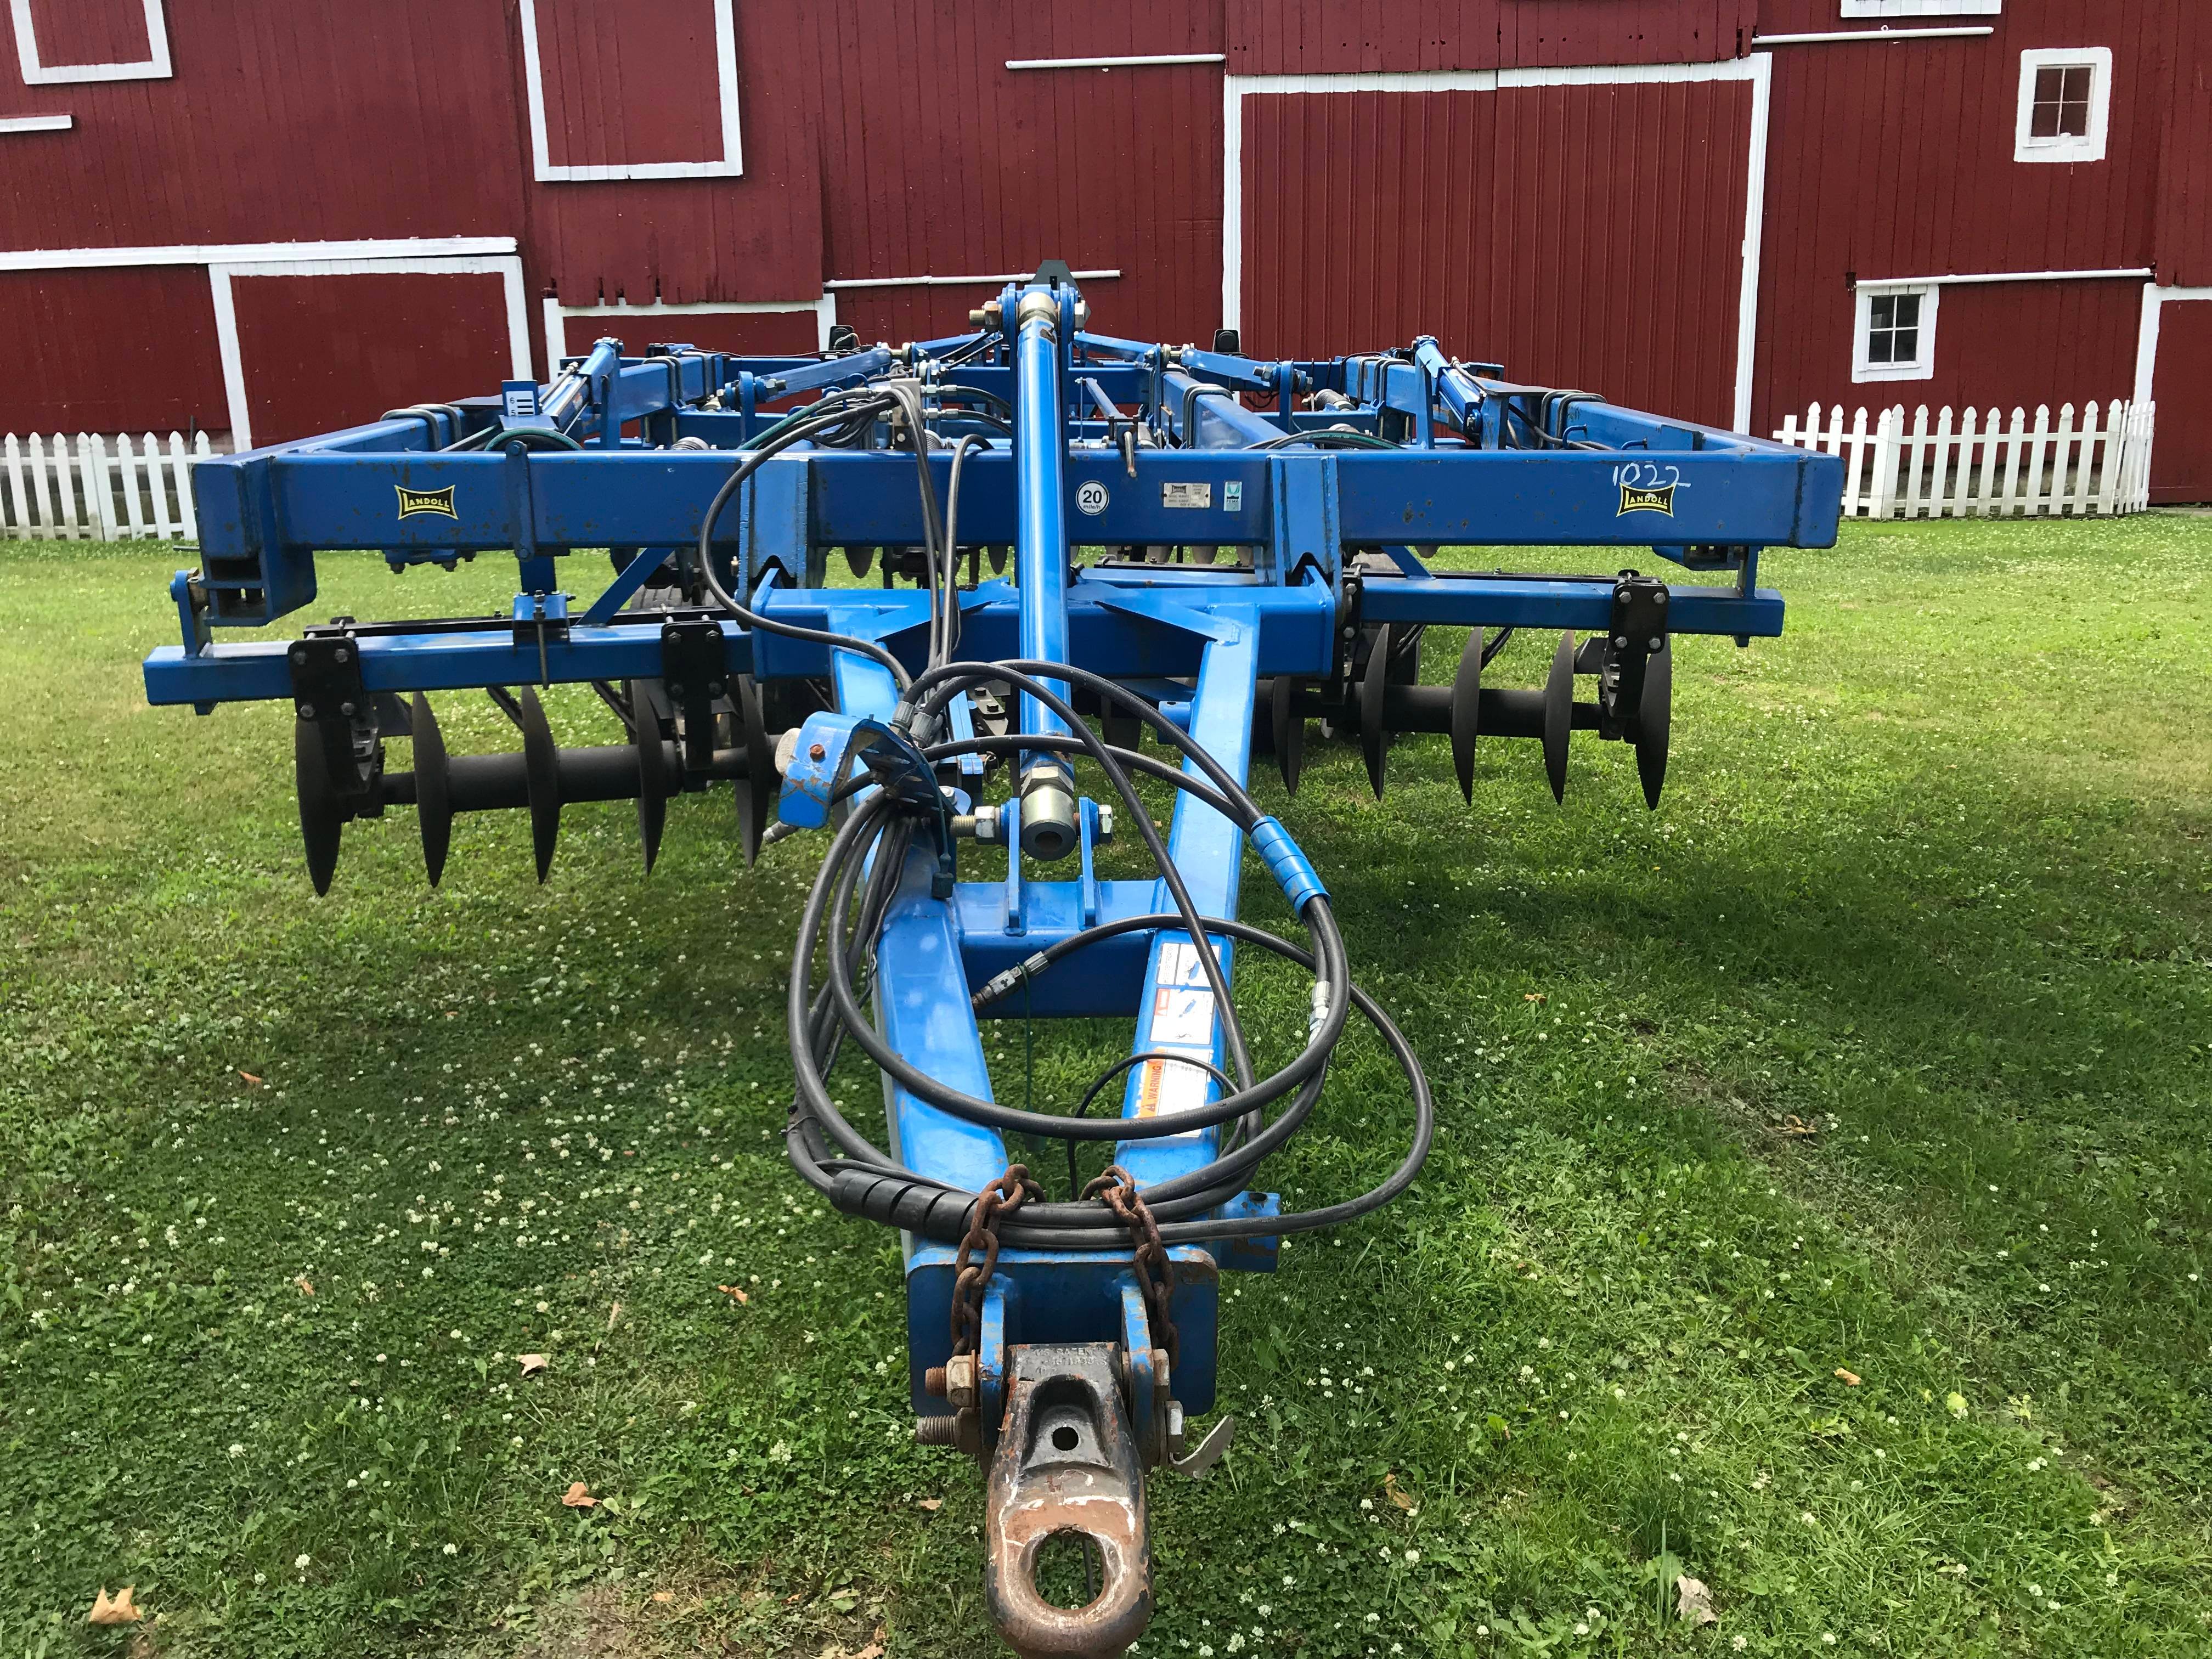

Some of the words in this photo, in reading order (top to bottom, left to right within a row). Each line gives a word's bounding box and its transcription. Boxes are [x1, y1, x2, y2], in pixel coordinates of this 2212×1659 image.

[1612, 462, 1691, 488] 1022
[402, 493, 450, 512] LANDOLL
[1083, 490, 1102, 504] 20
[1624, 490, 1668, 510] LANDOLL
[1147, 1065, 1162, 1100] WARNING
